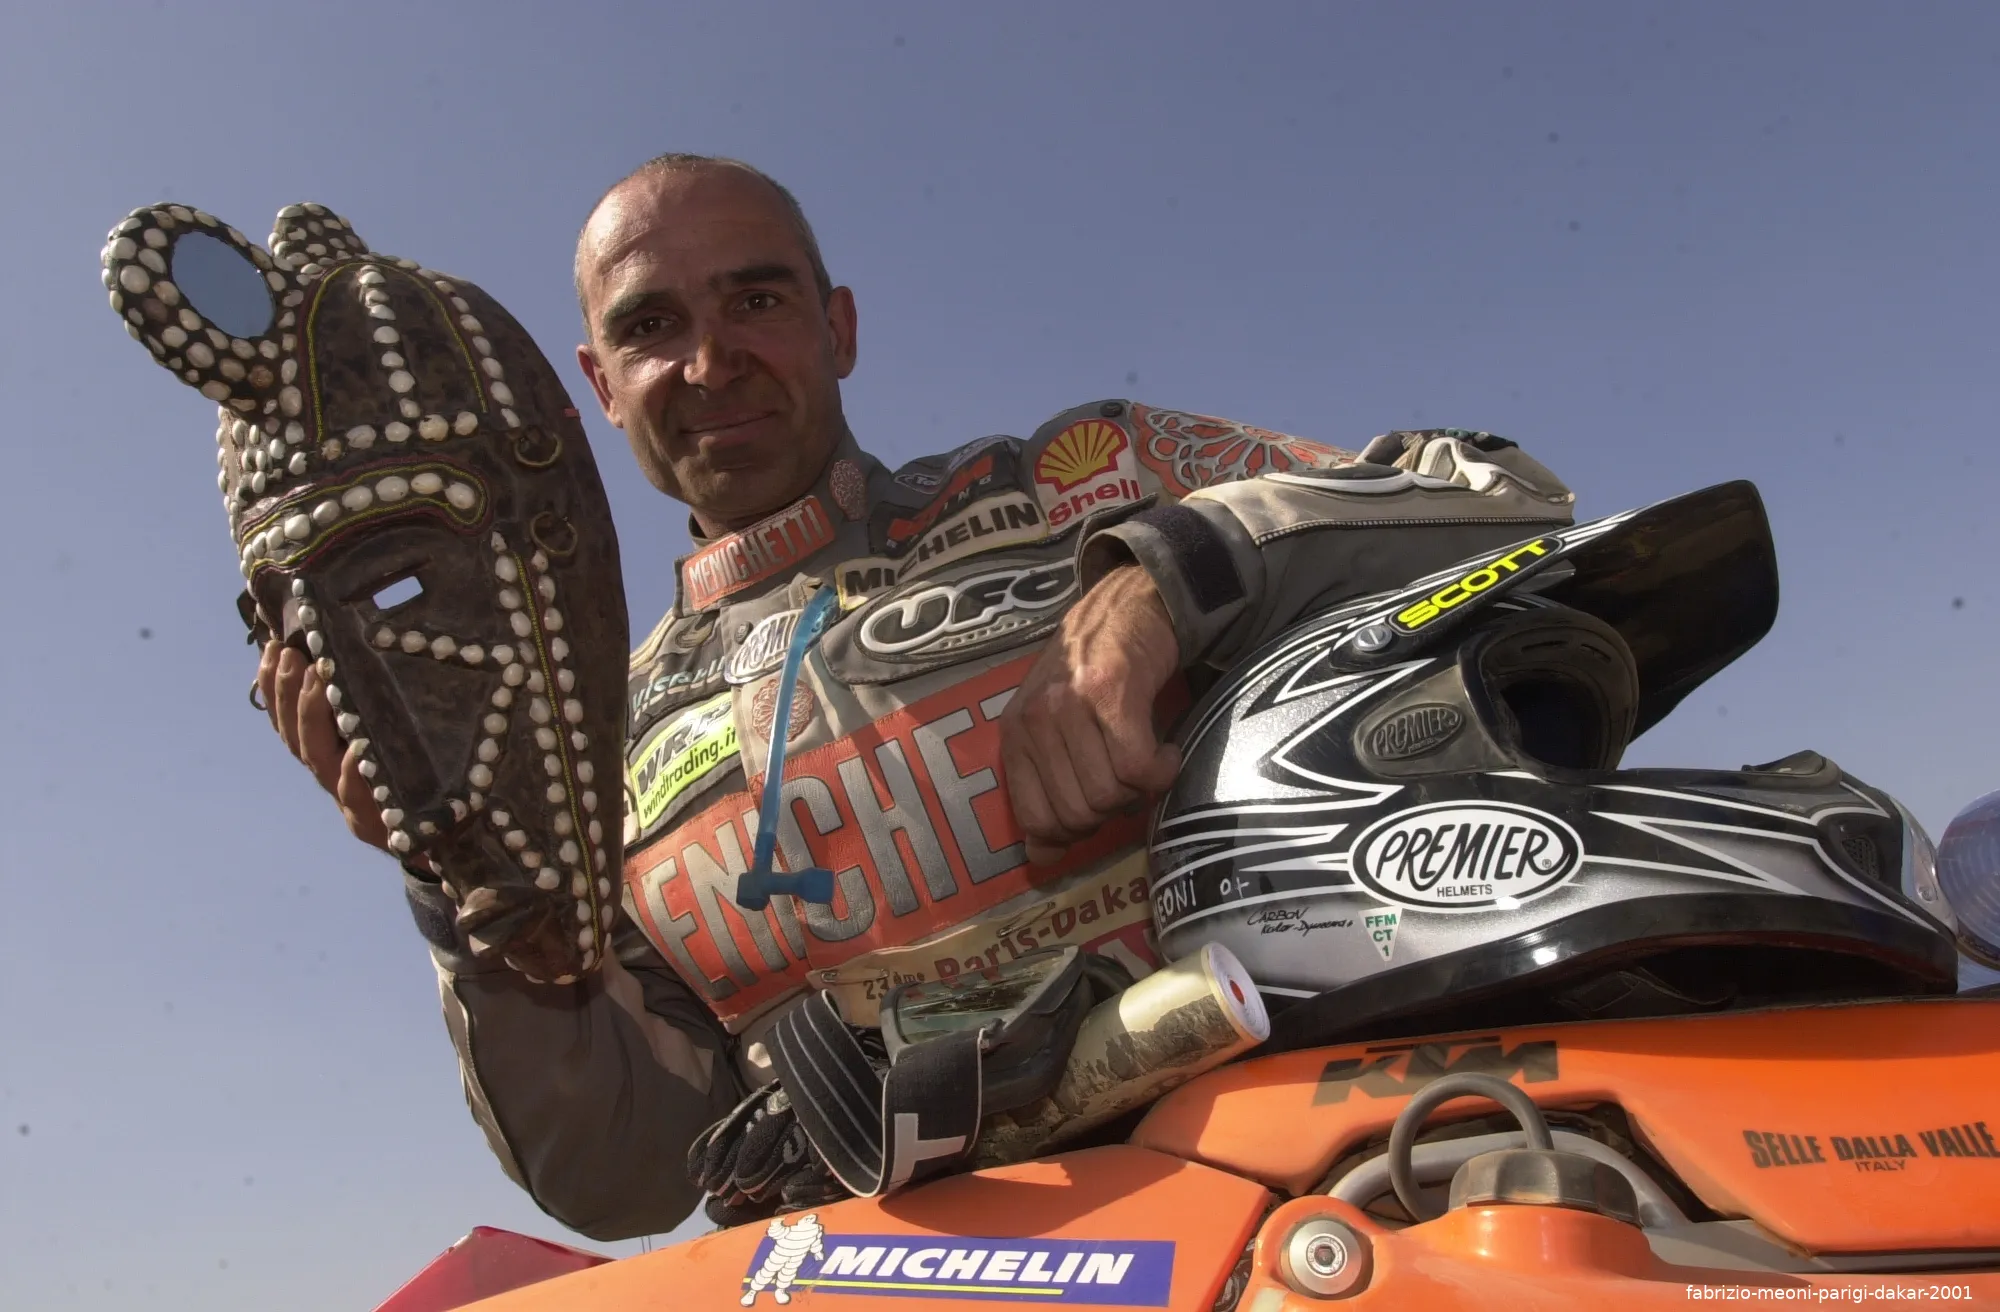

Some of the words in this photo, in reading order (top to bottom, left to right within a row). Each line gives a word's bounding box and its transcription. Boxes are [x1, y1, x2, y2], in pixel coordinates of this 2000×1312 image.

[688, 504, 825, 600] MENICHETTI
[1397, 539, 1549, 629] SCOTT
[1375, 822, 1571, 892] PREMIER
[1436, 883, 1493, 898] HELMETS
[934, 876, 1149, 987] Paris-Daka
[1365, 913, 1397, 928] FFM
[1373, 931, 1393, 943] CT
[1382, 945, 1391, 957] 1
[1311, 1034, 1559, 1107] KTM
[1742, 1130, 1827, 1169] SELLE
[1830, 1134, 1919, 1161] DALLA
[1918, 1121, 2000, 1158] VALLE
[1855, 1159, 1906, 1173] ITALY
[820, 1246, 1134, 1285] MICHELIN
